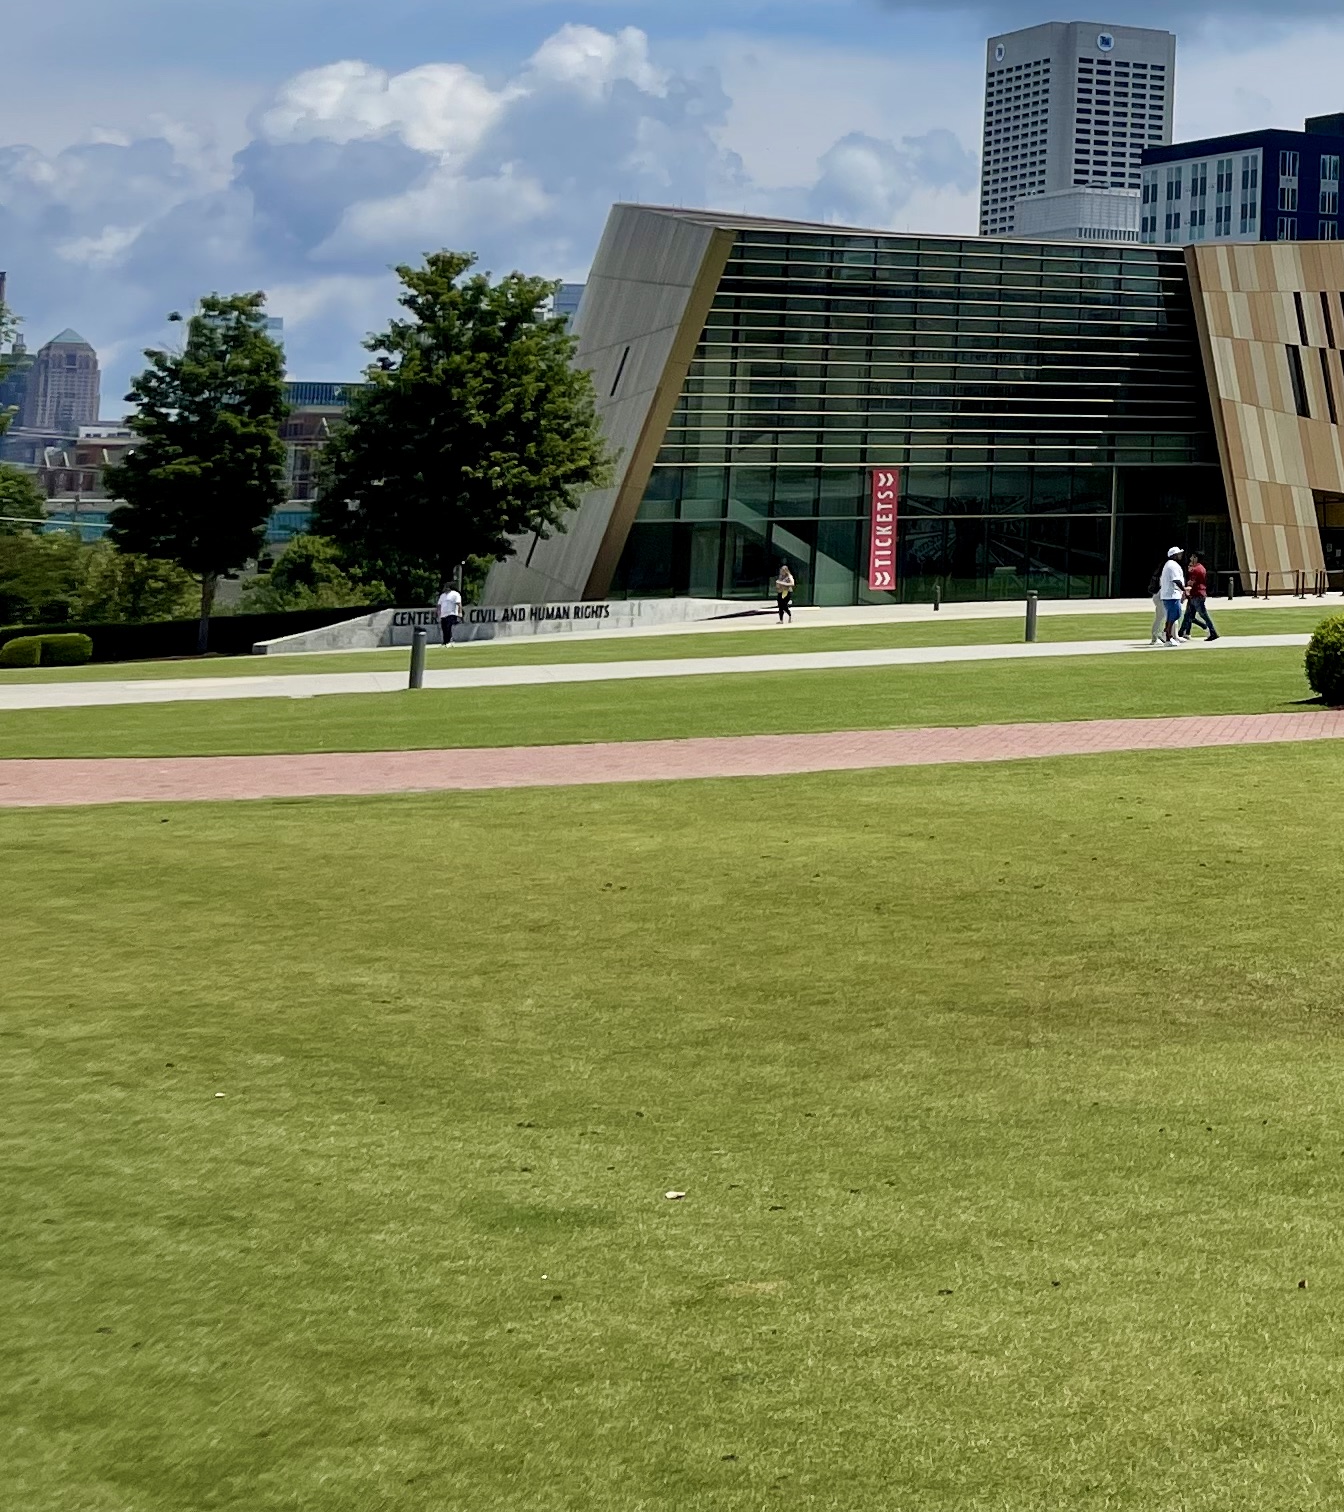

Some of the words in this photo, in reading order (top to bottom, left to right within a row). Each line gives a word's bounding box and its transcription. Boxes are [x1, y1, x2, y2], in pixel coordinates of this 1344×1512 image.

[874, 490, 894, 568] TICKETS
[393, 611, 438, 627] CENTER
[470, 608, 498, 623] CIVIL
[502, 607, 526, 622] AND
[530, 605, 570, 621] HUMAN
[574, 604, 610, 619] RIGHTS
